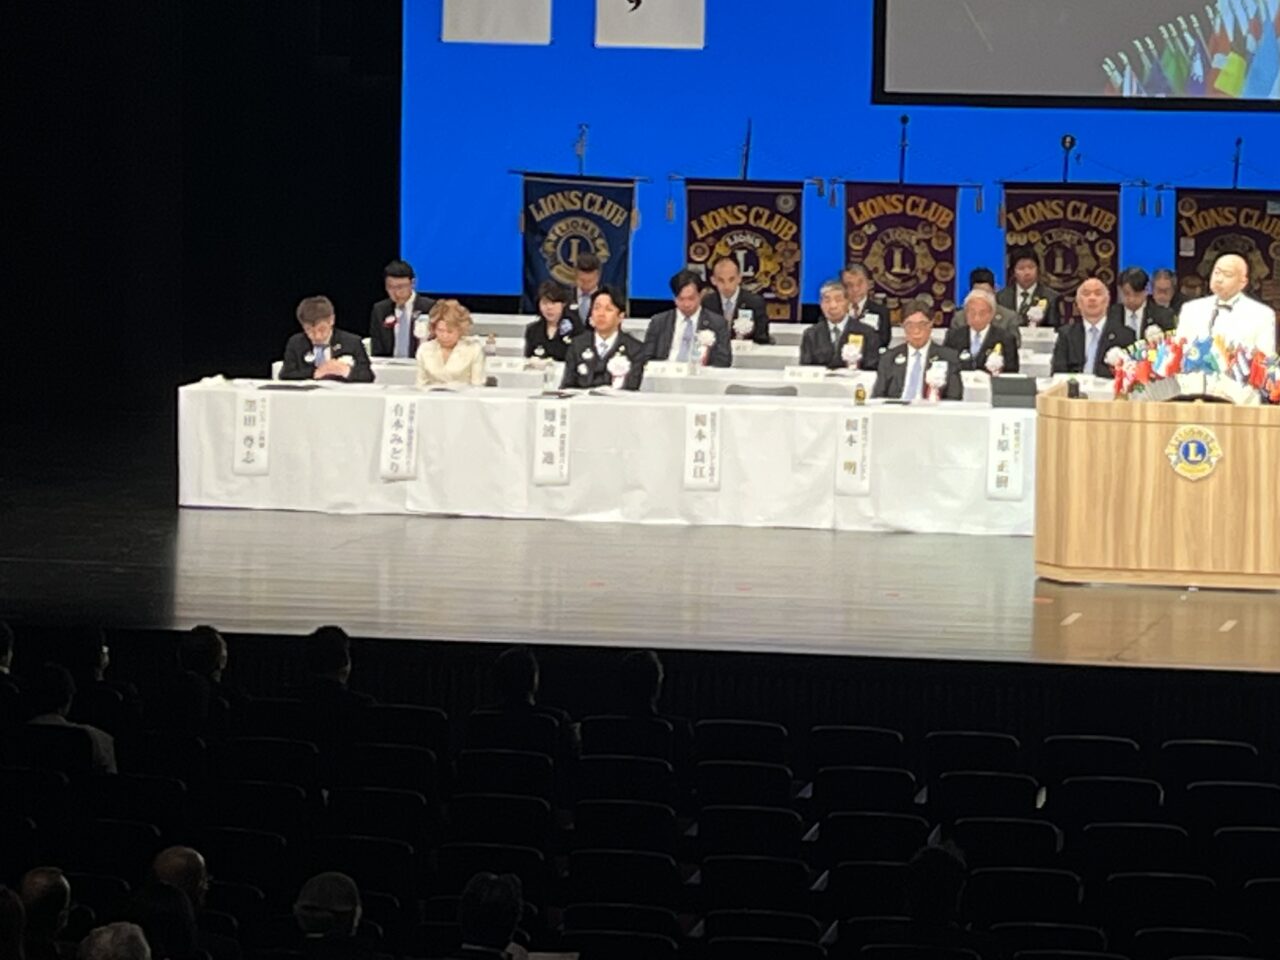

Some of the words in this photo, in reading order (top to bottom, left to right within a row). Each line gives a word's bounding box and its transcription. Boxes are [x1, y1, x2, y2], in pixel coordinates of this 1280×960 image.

[528, 190, 582, 222] LIONS
[583, 192, 628, 227] CLUB
[690, 204, 748, 239] LIONS
[748, 206, 798, 240] CLUB
[848, 194, 905, 225] LIONS
[905, 196, 954, 229] CLUB
[1007, 199, 1065, 231] LIONS
[1066, 200, 1117, 233] CLUB
[1179, 207, 1238, 237] LIONS
[734, 249, 755, 276] L
[1187, 442, 1202, 461] L
